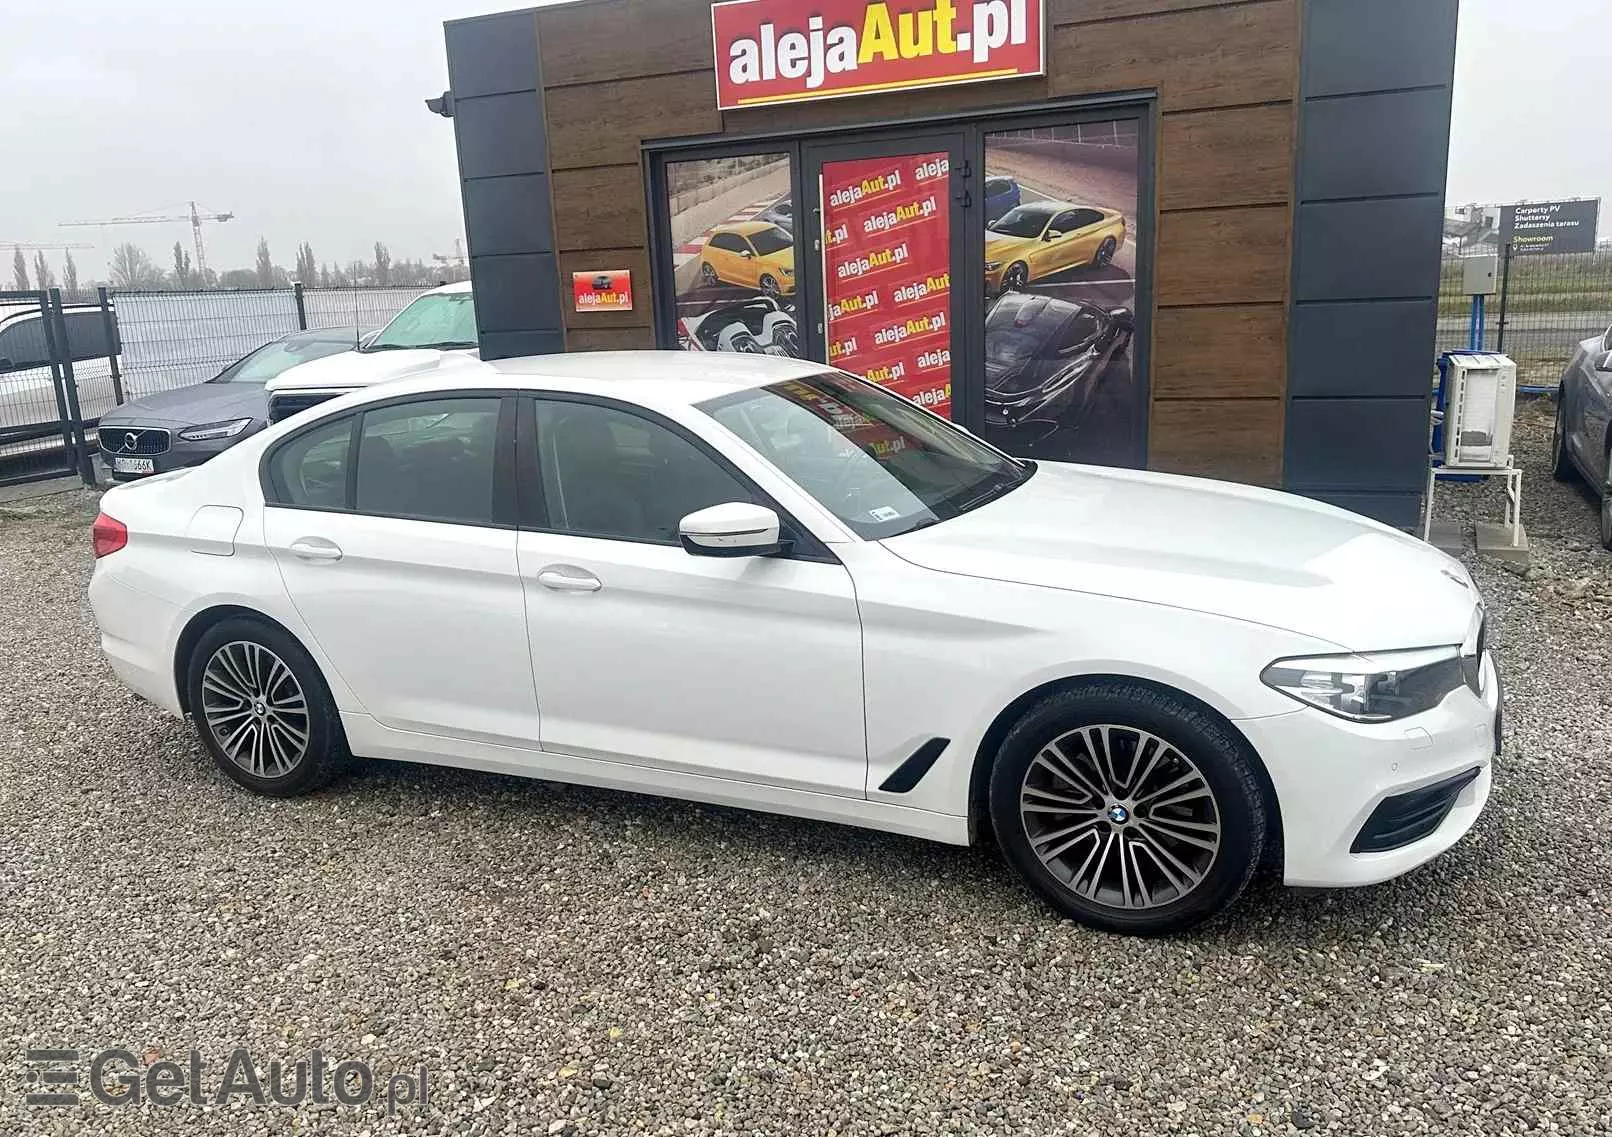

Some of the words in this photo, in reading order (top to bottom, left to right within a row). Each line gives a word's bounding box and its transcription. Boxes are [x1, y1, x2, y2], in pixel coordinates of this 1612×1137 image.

[729, 0, 1026, 89] alejaAut.pl
[914, 158, 950, 181] aleja
[829, 169, 901, 207] alejaAut.pl
[863, 196, 936, 233] alejaAut.pl
[837, 243, 909, 278] alejaAut.pl
[578, 291, 629, 305] alejaAut.pl
[874, 311, 947, 345] alejaAut.pl
[917, 348, 952, 369] aleja
